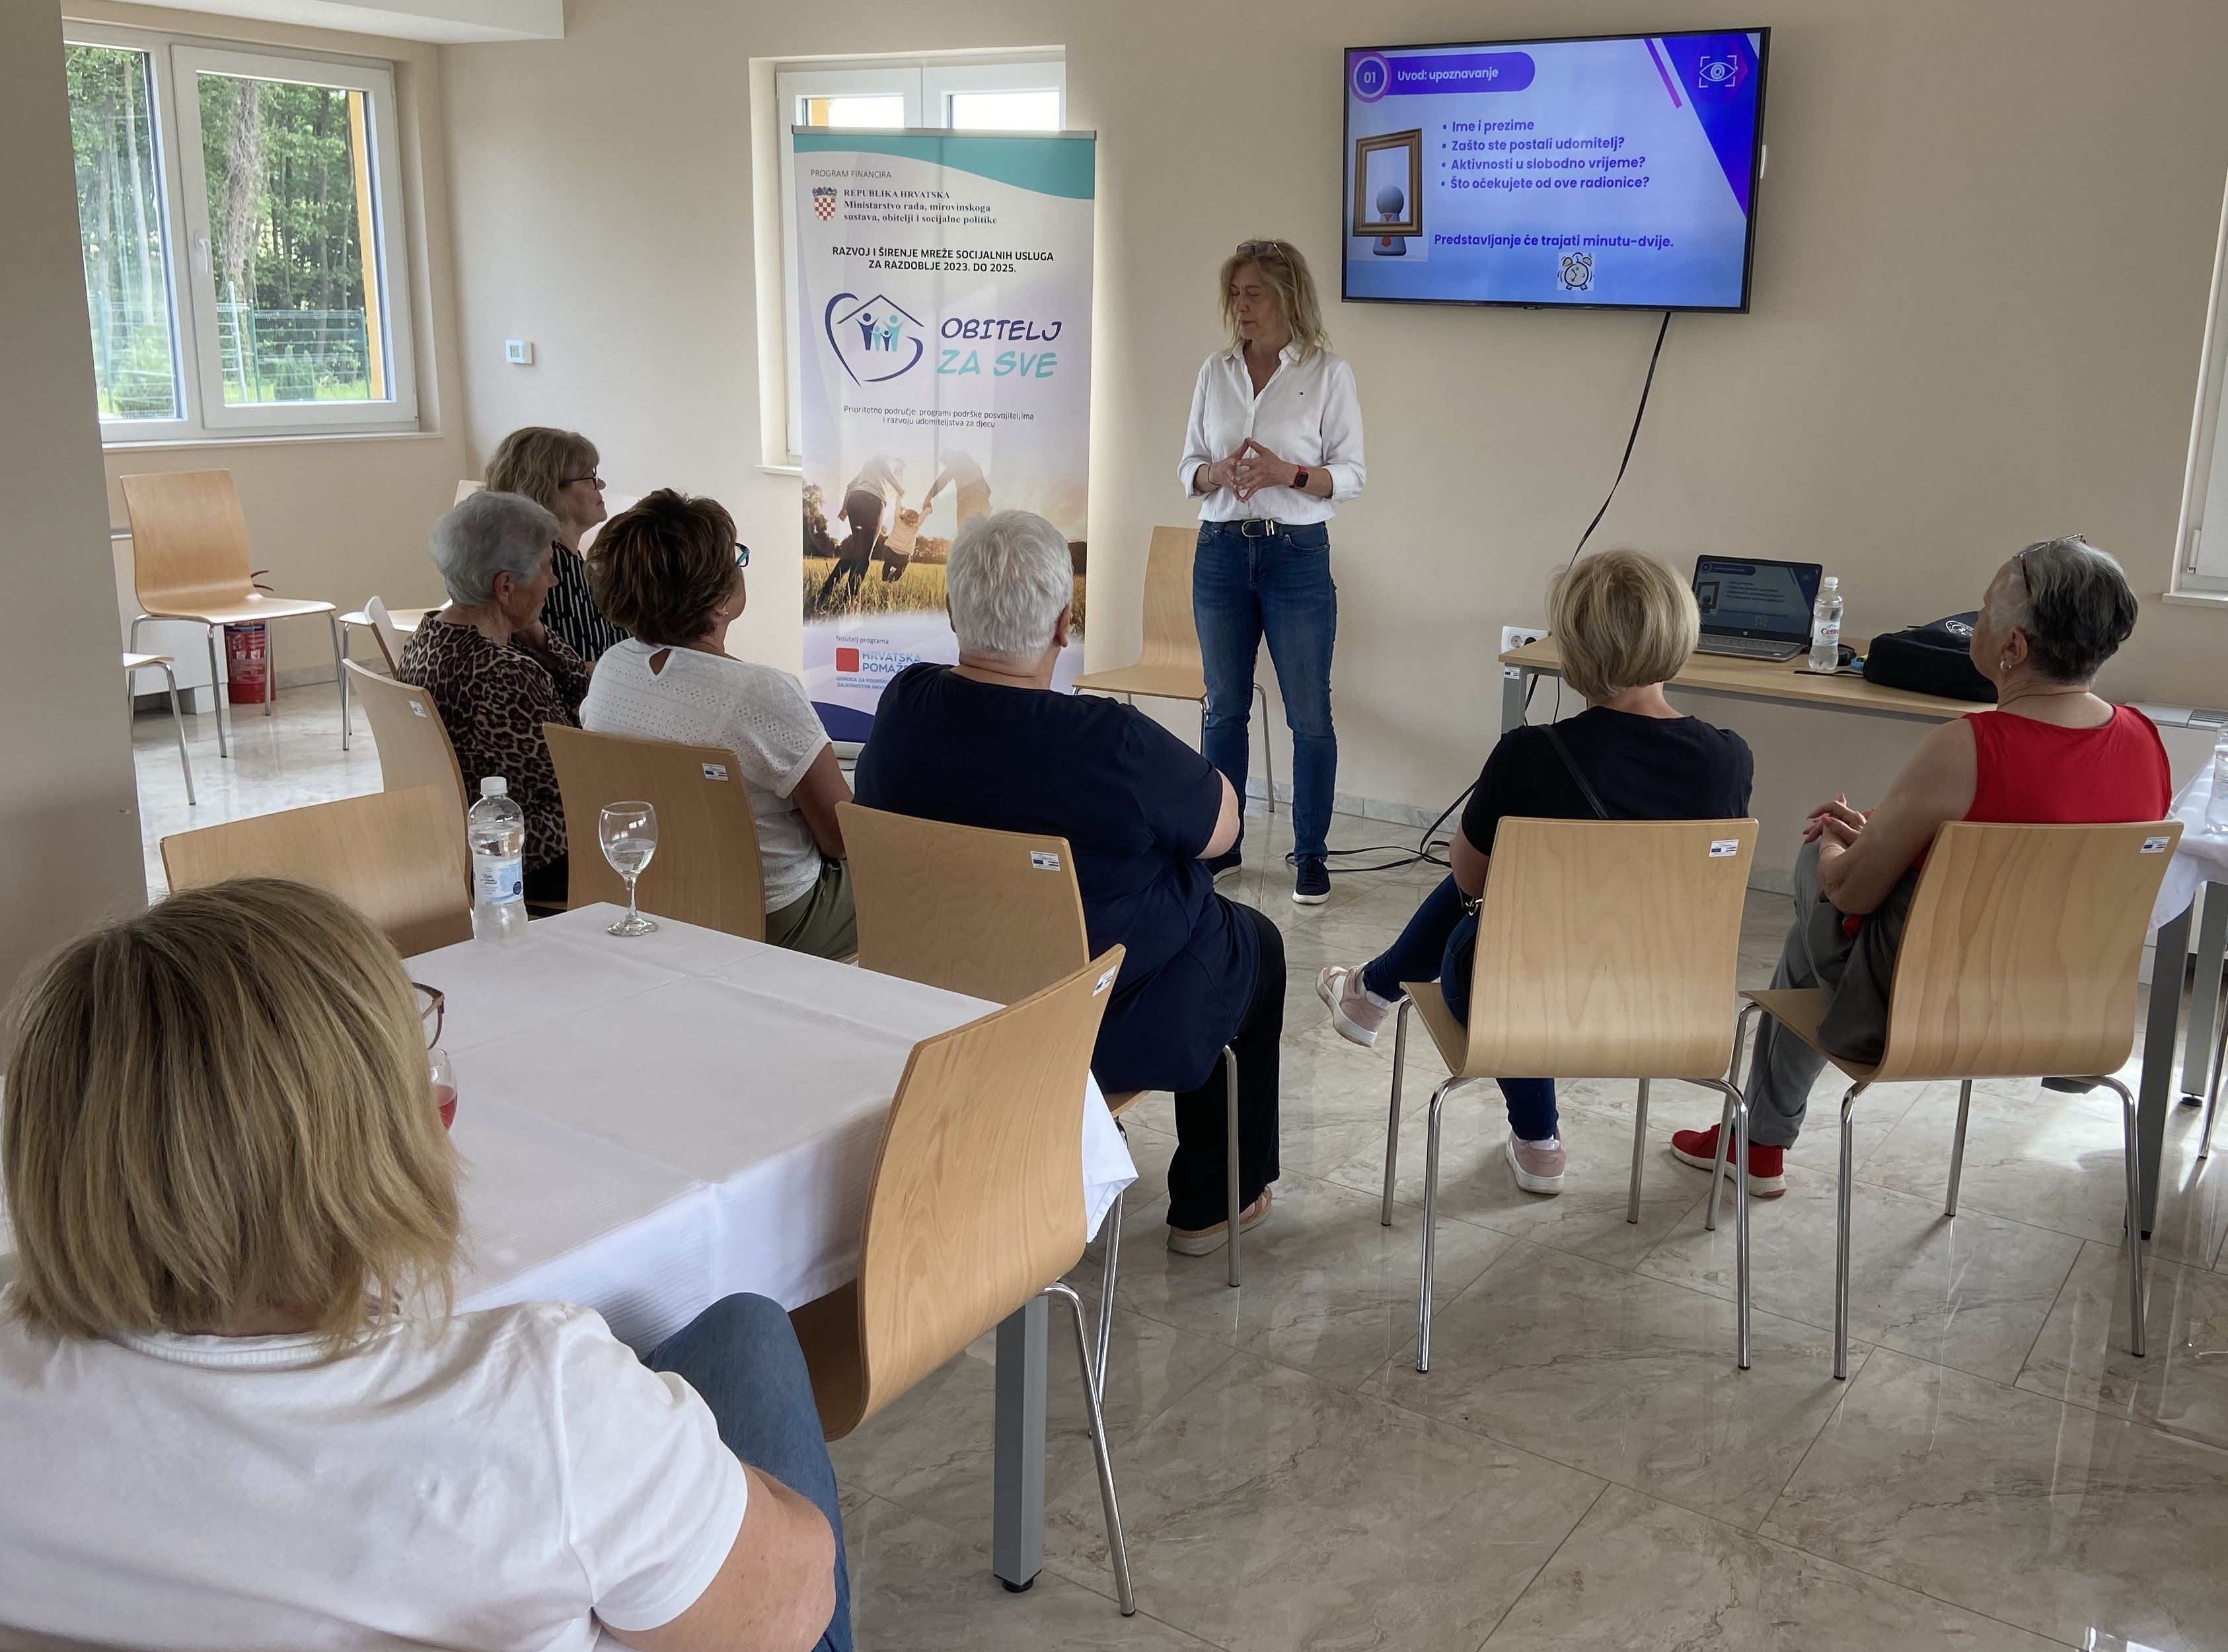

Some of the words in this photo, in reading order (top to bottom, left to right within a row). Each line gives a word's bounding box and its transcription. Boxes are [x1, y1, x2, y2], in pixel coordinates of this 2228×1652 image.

[1364, 71, 1377, 84] 01
[1397, 68, 1427, 82] Uvod:
[1429, 67, 1499, 84] upoznavanje
[1453, 120, 1475, 132] Ime
[1478, 120, 1481, 132] i
[1485, 120, 1534, 135] prezime
[1452, 137, 1484, 151] Zašto
[1487, 140, 1506, 150] ste
[1510, 138, 1553, 153] postali
[1555, 137, 1625, 153] udomitelj?
[1451, 157, 1513, 170] Aktivnosti
[1516, 161, 1524, 170] u
[1526, 157, 1585, 169] slobodno
[1588, 156, 1646, 170] vrijeme?
[810, 169, 849, 178] PROGRAM
[851, 170, 892, 179] FINANCIRA
[1450, 176, 1469, 190] Što
[1473, 176, 1533, 192] očekujete
[1536, 177, 1551, 189] od
[1554, 180, 1577, 188] ove
[1580, 176, 1650, 189] radionice?
[844, 189, 897, 198] REPUBLIKA
[901, 190, 949, 199] HRVATSKA
[844, 200, 901, 210] Ministarstvo
[903, 202, 928, 212] rada,
[930, 203, 990, 213] mirovinskoga
[882, 215, 914, 224] obitelji
[922, 215, 961, 225] socijalne
[963, 216, 997, 225] politike
[1434, 234, 1521, 250] Predstavljanje
[1524, 235, 1538, 246] će
[1541, 235, 1580, 250] trajati
[1583, 235, 1674, 251] minutu-dvije.
[833, 247, 870, 256] RAZVOJ
[873, 248, 876, 256] I
[879, 247, 918, 258] ŠIRENJE
[921, 248, 953, 258] MREŽE
[956, 250, 1012, 260] SOCIJALNIH
[1015, 252, 1054, 261] USLUGA
[868, 260, 881, 269] ZA
[884, 260, 941, 270] RAZDOBLJE
[944, 262, 971, 272] 2023.
[973, 263, 987, 272] DO
[990, 264, 1017, 273] 2025.
[941, 318, 1062, 341] OBITELJ
[937, 350, 981, 375] ZA
[993, 352, 1058, 378] SVE
[844, 405, 883, 414] Prioritetno
[984, 412, 1035, 420] posvojiteljima
[916, 417, 964, 426] udomiteljstva
[836, 635, 858, 644] Nositelj
[862, 651, 922, 663] HRVATSKA
